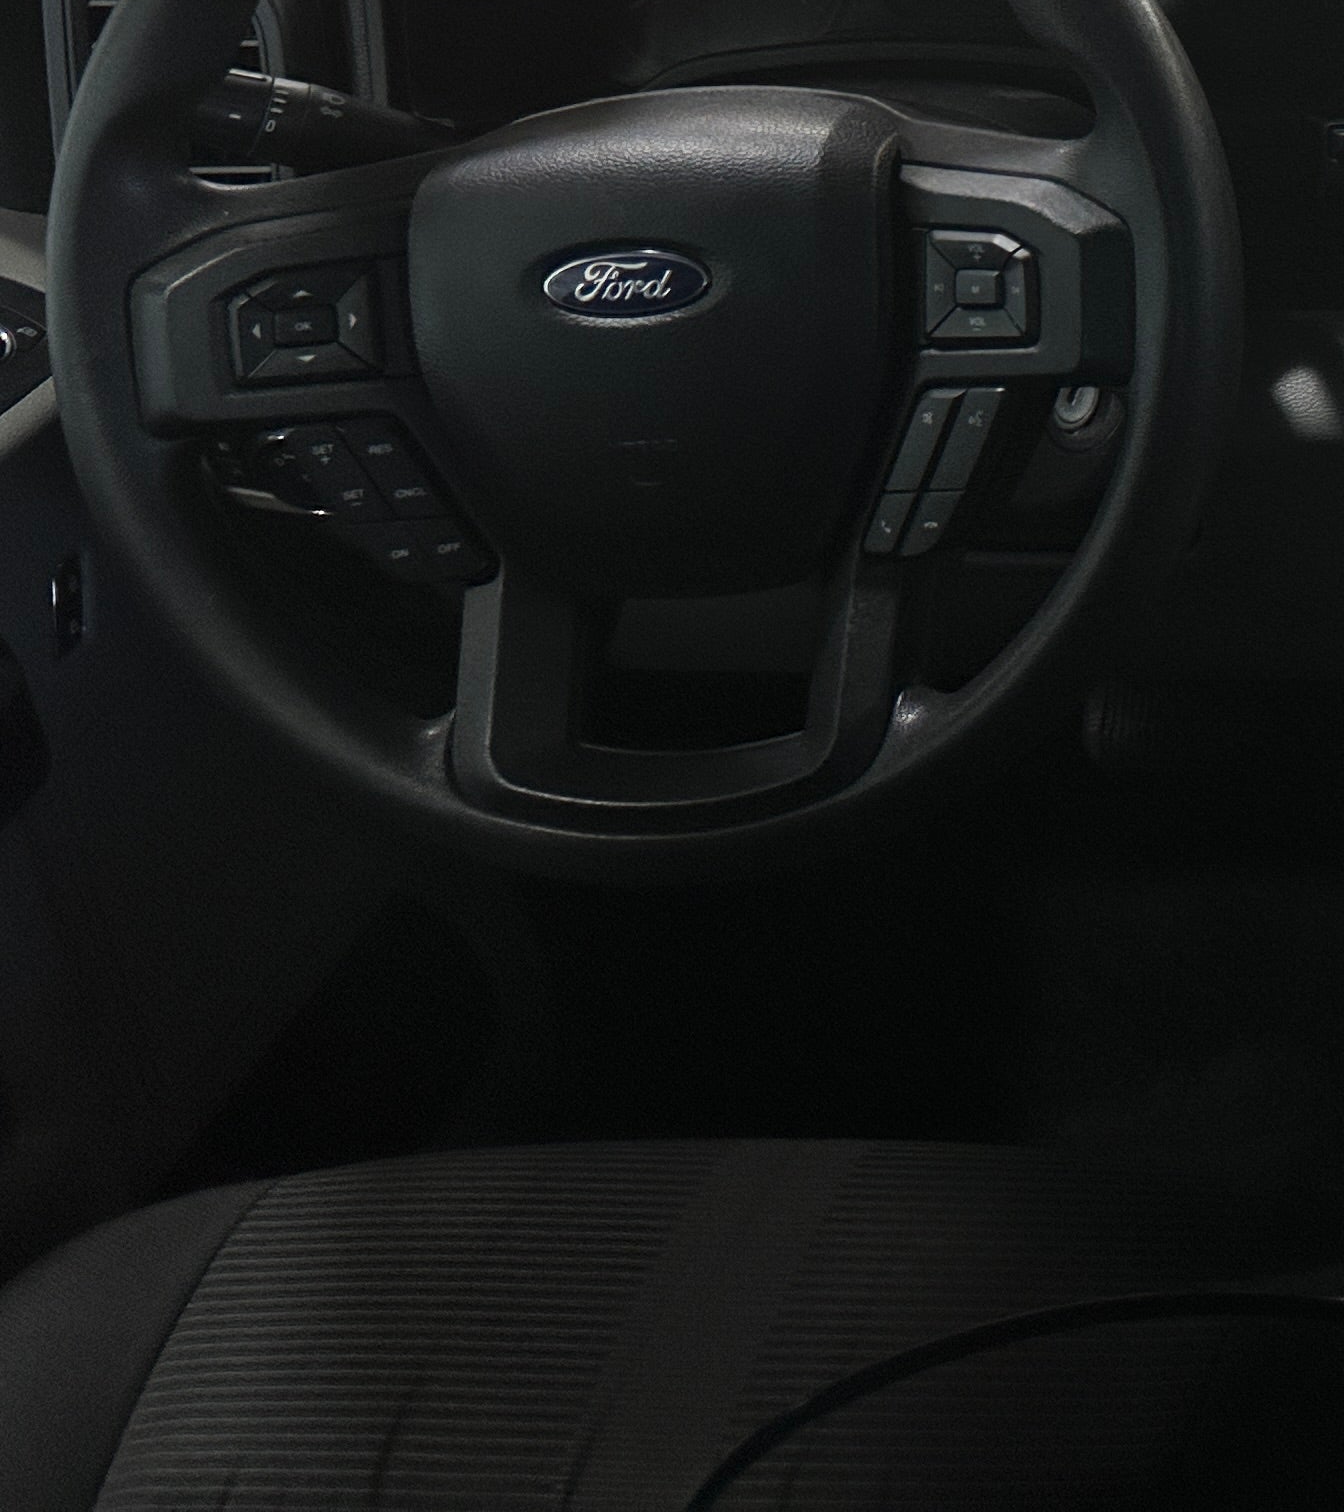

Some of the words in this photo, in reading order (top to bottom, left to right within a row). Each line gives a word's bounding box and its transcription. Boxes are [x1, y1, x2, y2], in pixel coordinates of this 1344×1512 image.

[575, 261, 673, 303] Ford
[311, 444, 334, 455] SET
[342, 489, 364, 501] SET
[437, 543, 461, 554] OFF
